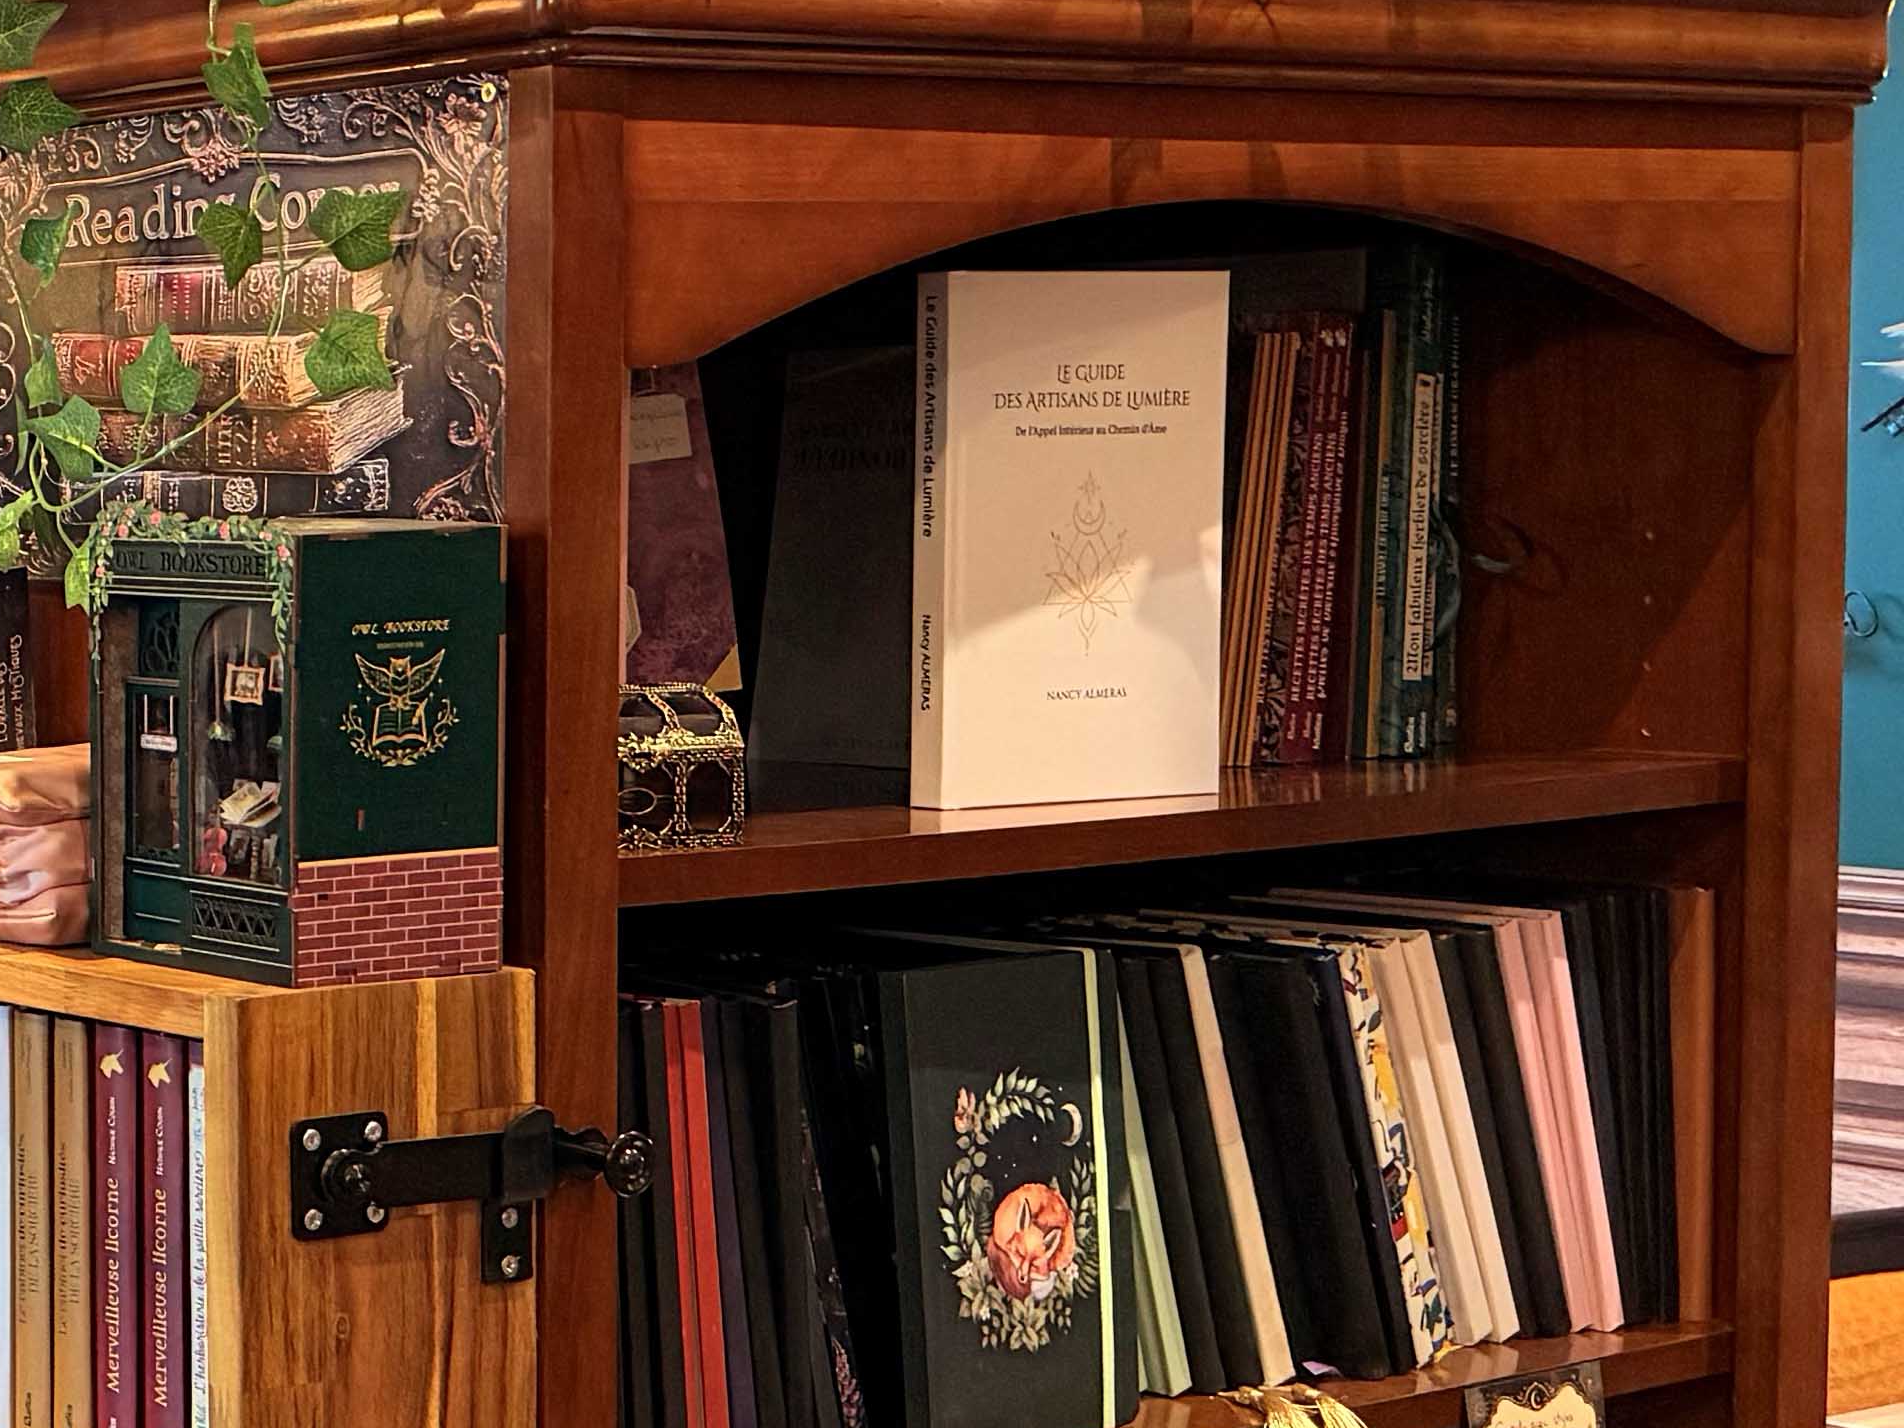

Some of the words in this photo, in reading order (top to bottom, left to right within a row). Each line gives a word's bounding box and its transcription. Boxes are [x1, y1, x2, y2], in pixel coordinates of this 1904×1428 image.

[65, 183, 236, 249] Readin
[994, 393, 1022, 410] DES
[1026, 392, 1098, 412] ARTISANS
[1103, 392, 1122, 408] DE
[1126, 389, 1190, 410] LUMIÈRE
[1057, 364, 1071, 383] LE
[1076, 364, 1125, 382] GUIDE
[923, 390, 936, 452] Artisans
[161, 551, 266, 575] BOOKSTORE
[104, 1178, 120, 1253] licorne
[152, 1189, 167, 1265] licorne
[104, 1259, 120, 1393] Merveilleuse
[152, 1272, 168, 1407] Merveilleuse
